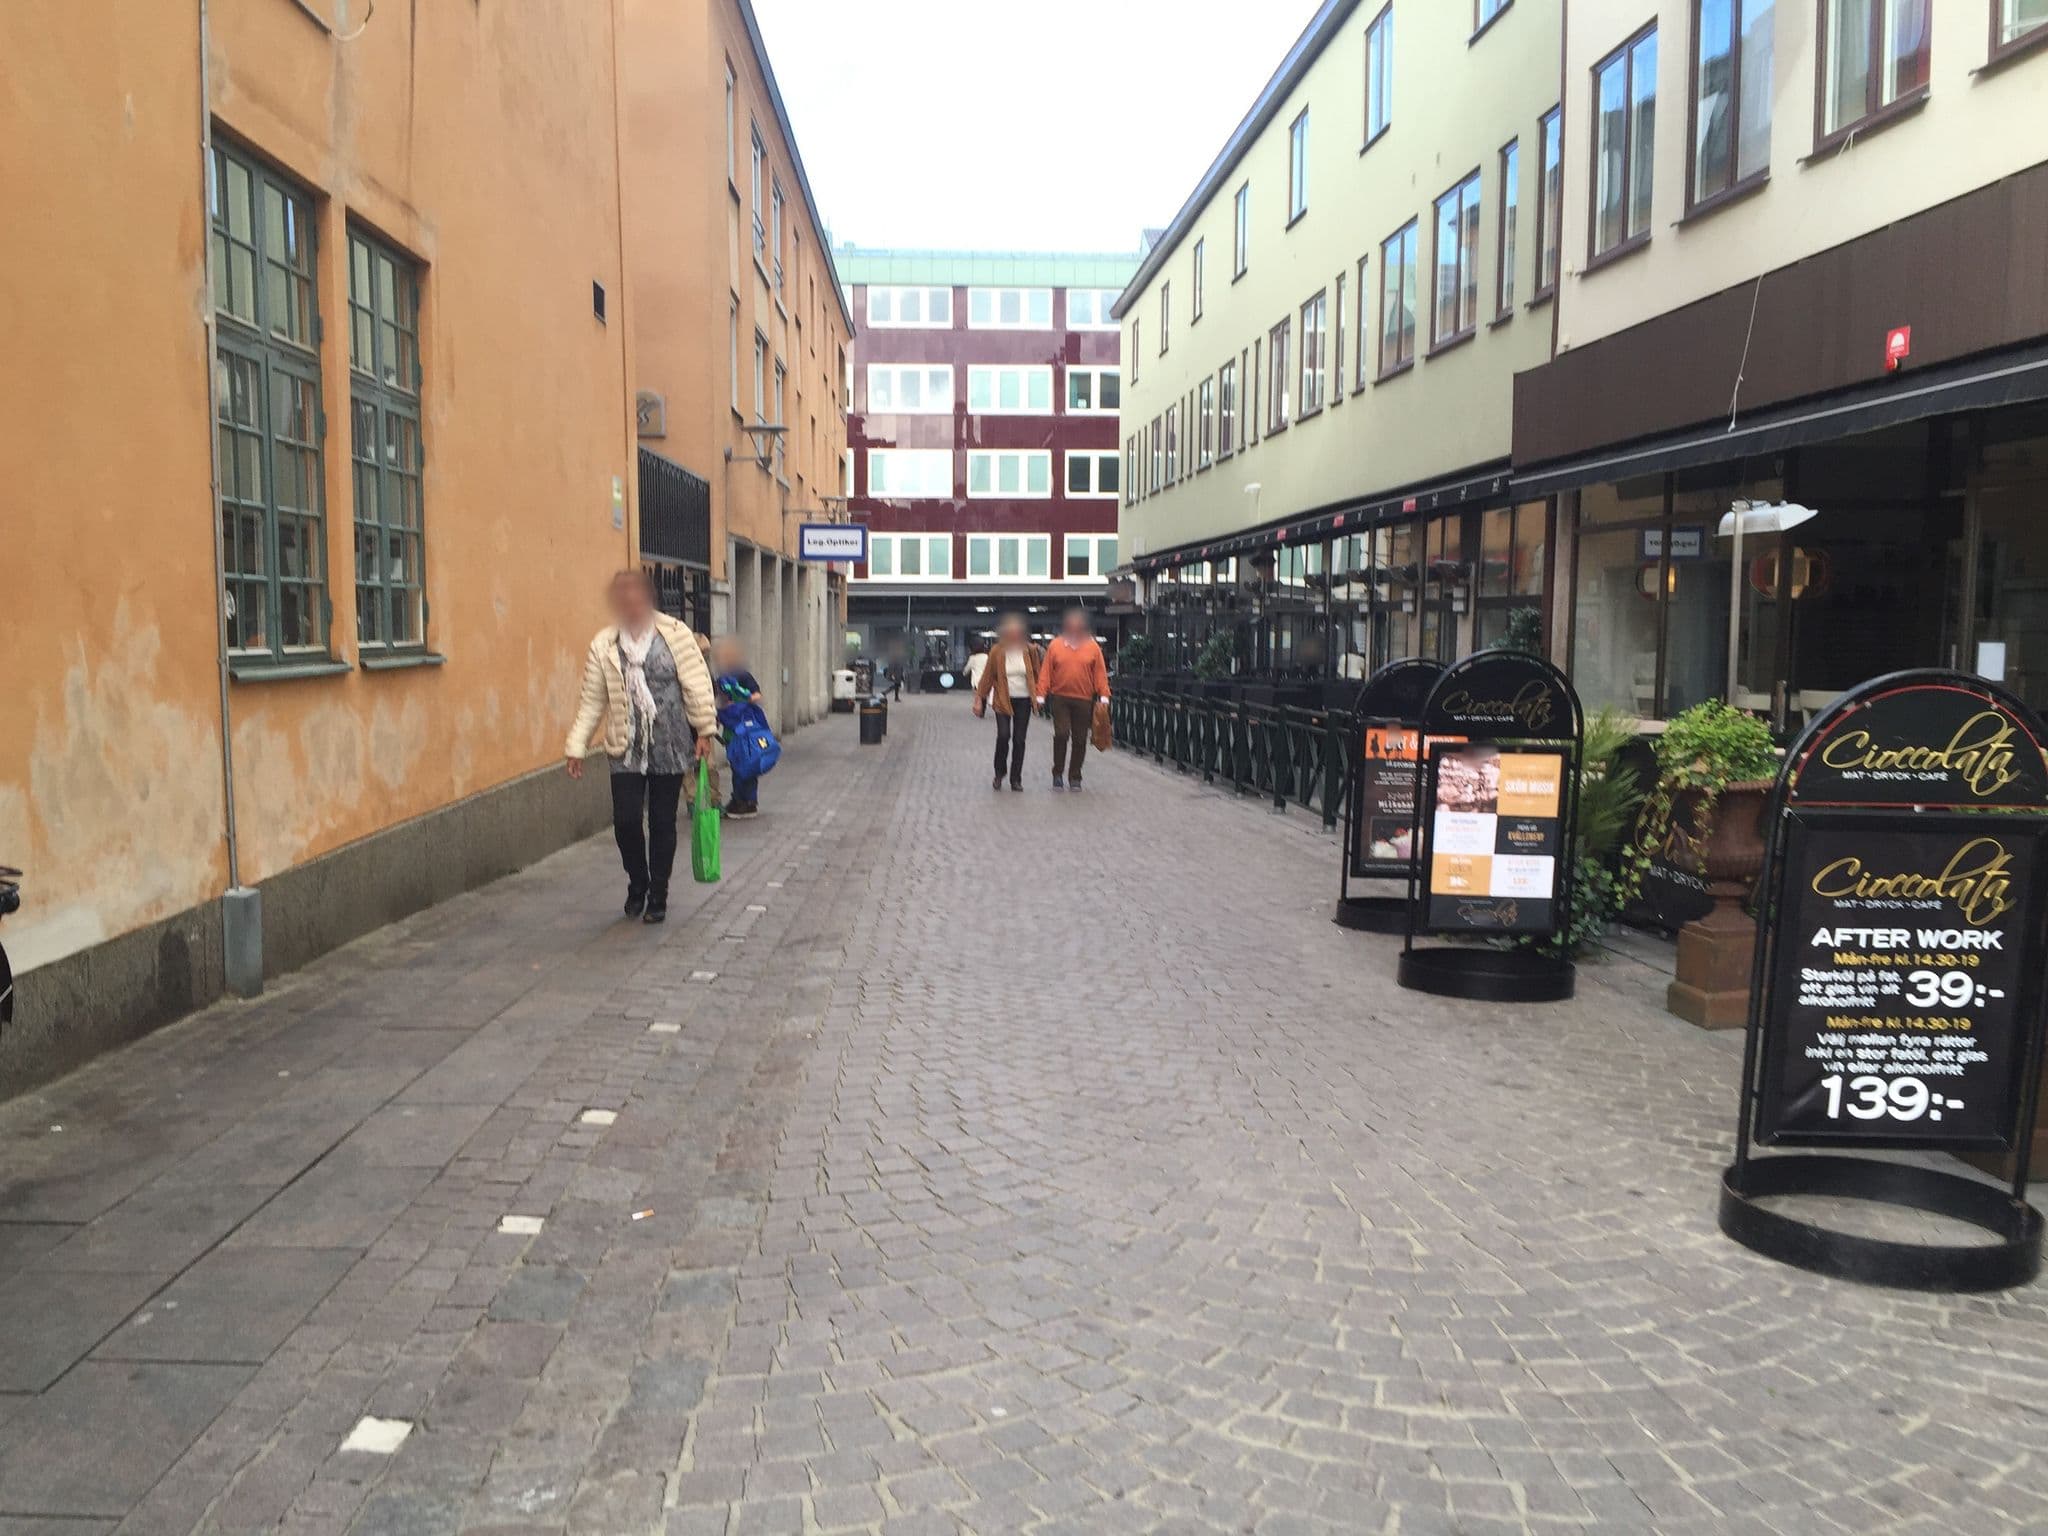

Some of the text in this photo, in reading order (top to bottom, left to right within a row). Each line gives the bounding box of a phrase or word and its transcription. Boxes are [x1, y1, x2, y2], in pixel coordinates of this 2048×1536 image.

[1822, 711, 2021, 796] Cioccolata
[1811, 837, 2017, 926] Cioccolata
[1811, 928, 2005, 950] AFTER WORK
[1905, 970, 2005, 1008] 39:-
[1855, 1047, 1889, 1060] stor
[1821, 1074, 1965, 1121] 139:-
